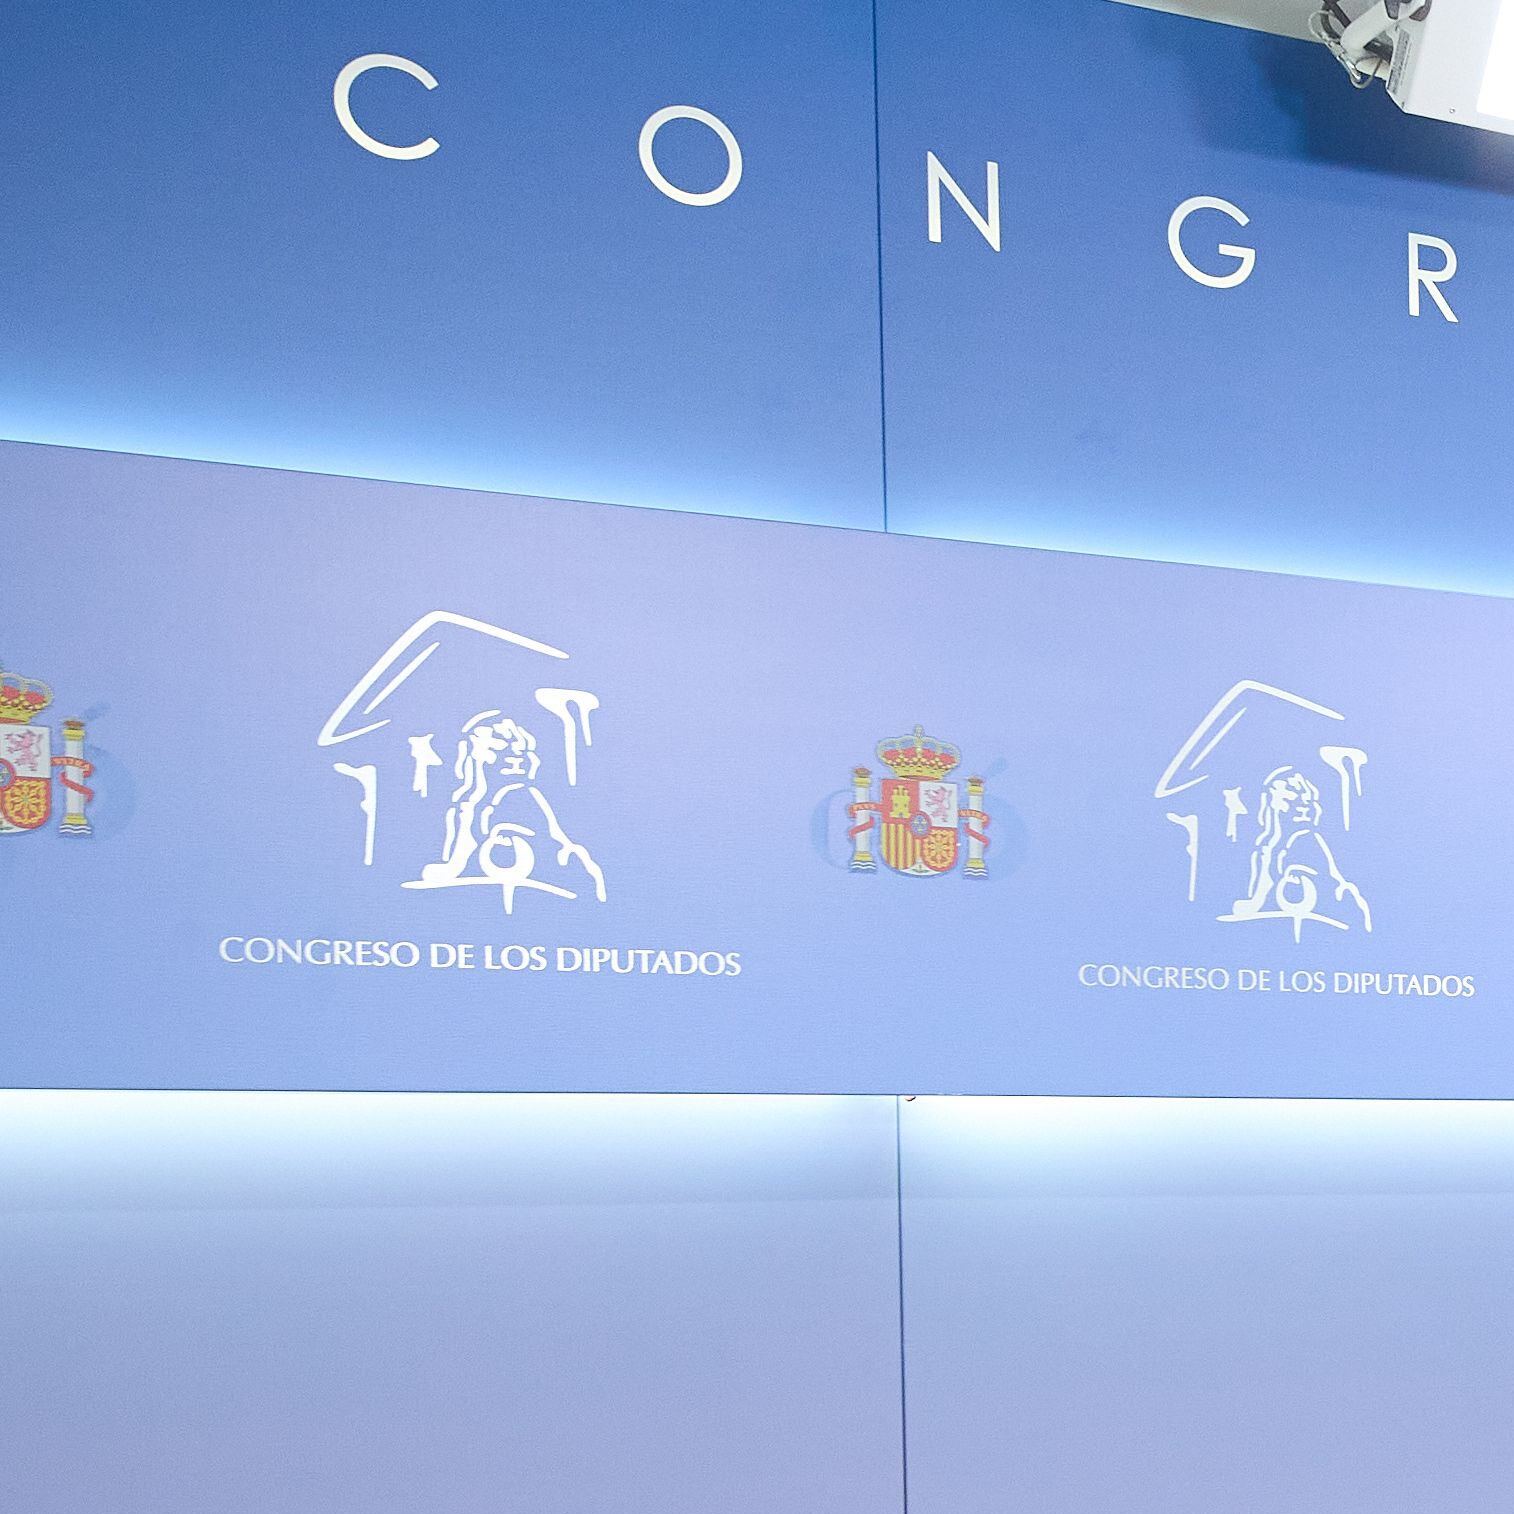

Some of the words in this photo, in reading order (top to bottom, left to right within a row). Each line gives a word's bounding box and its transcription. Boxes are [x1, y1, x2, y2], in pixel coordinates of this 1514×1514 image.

[219, 935, 421, 968] CONGRESO
[429, 943, 476, 970] DE
[484, 945, 548, 972] LOS
[556, 947, 743, 977] DIPUTADOS
[1078, 964, 1231, 990] CONGRESO
[1238, 969, 1272, 992] DE
[1279, 971, 1327, 994] LOS
[1334, 972, 1476, 998] DIPUTADOS
